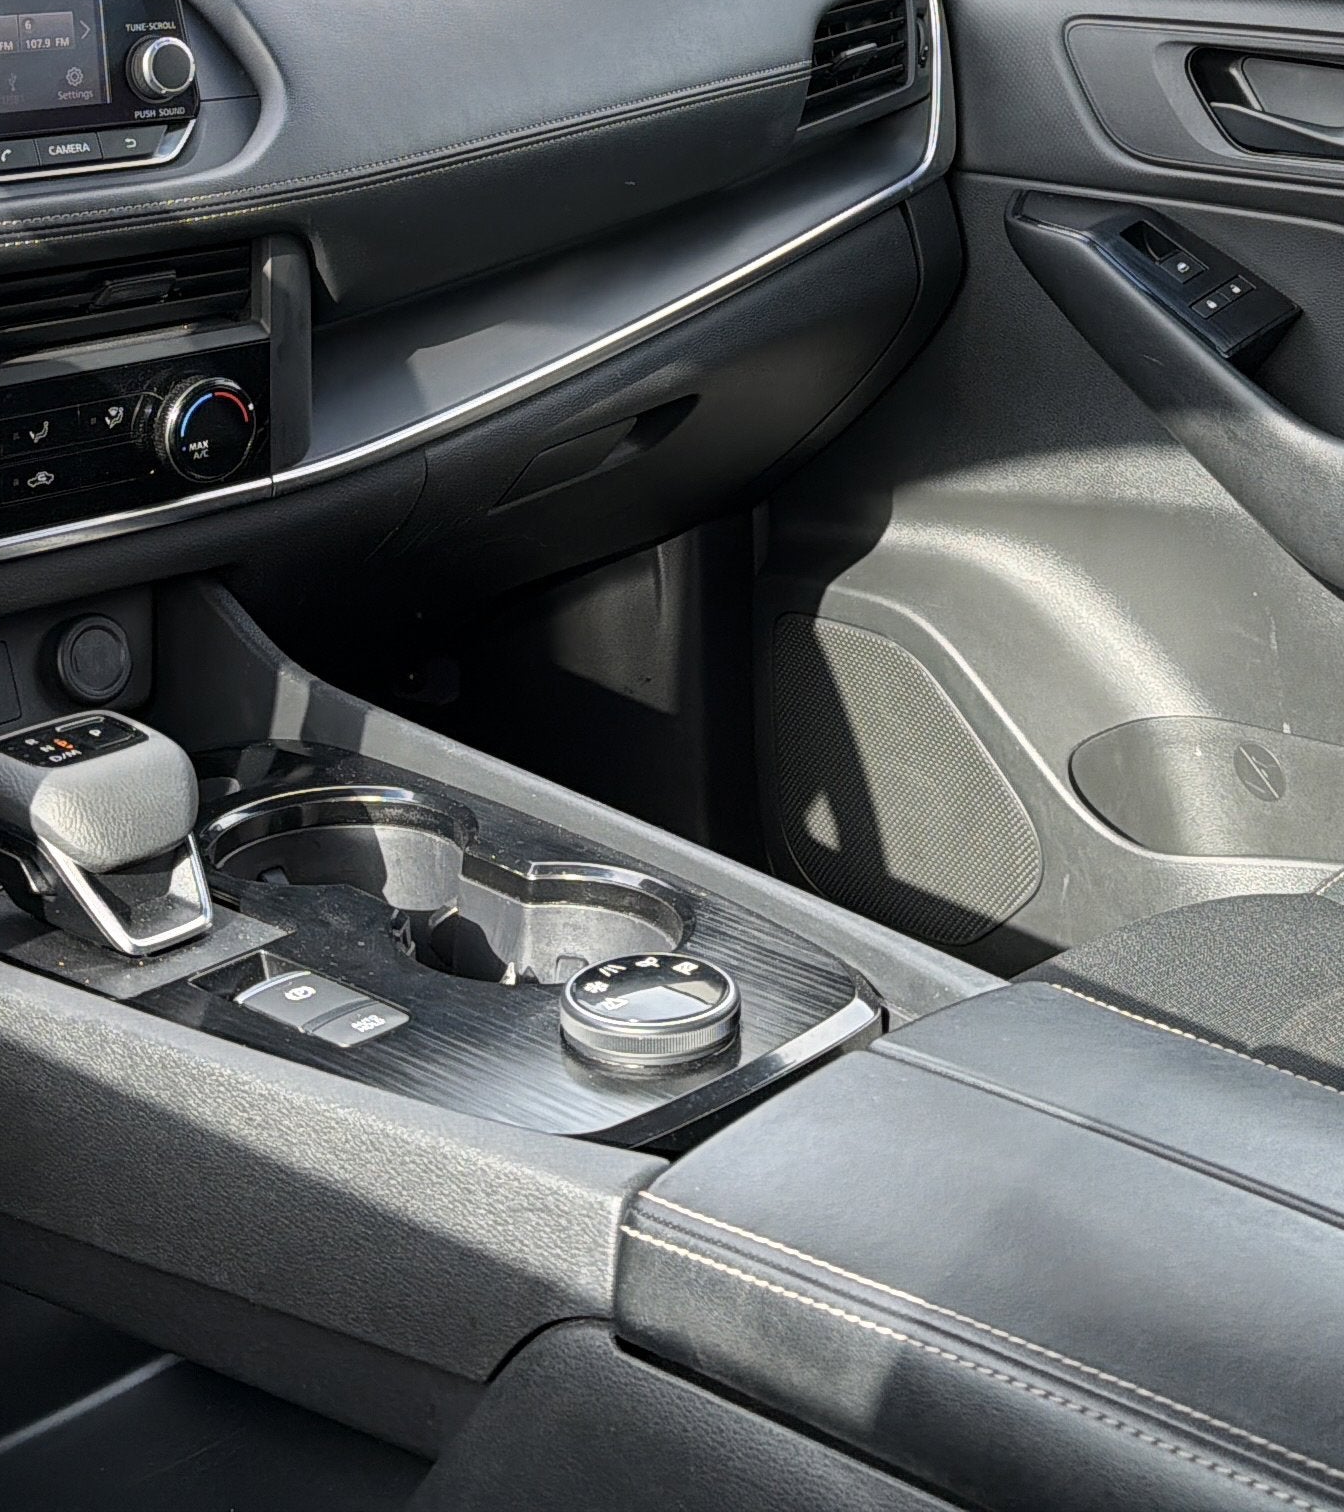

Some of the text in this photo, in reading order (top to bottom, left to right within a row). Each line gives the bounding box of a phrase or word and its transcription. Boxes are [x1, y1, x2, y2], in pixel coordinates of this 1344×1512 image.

[24, 20, 32, 30] 6
[0, 41, 14, 51] FM
[26, 37, 70, 49] 107.9 FM
[58, 88, 94, 102] Settings
[134, 106, 185, 119] PUSH SOUND
[48, 142, 91, 156] CAMERA
[189, 440, 209, 452] MAX
[193, 449, 209, 460] A/C
